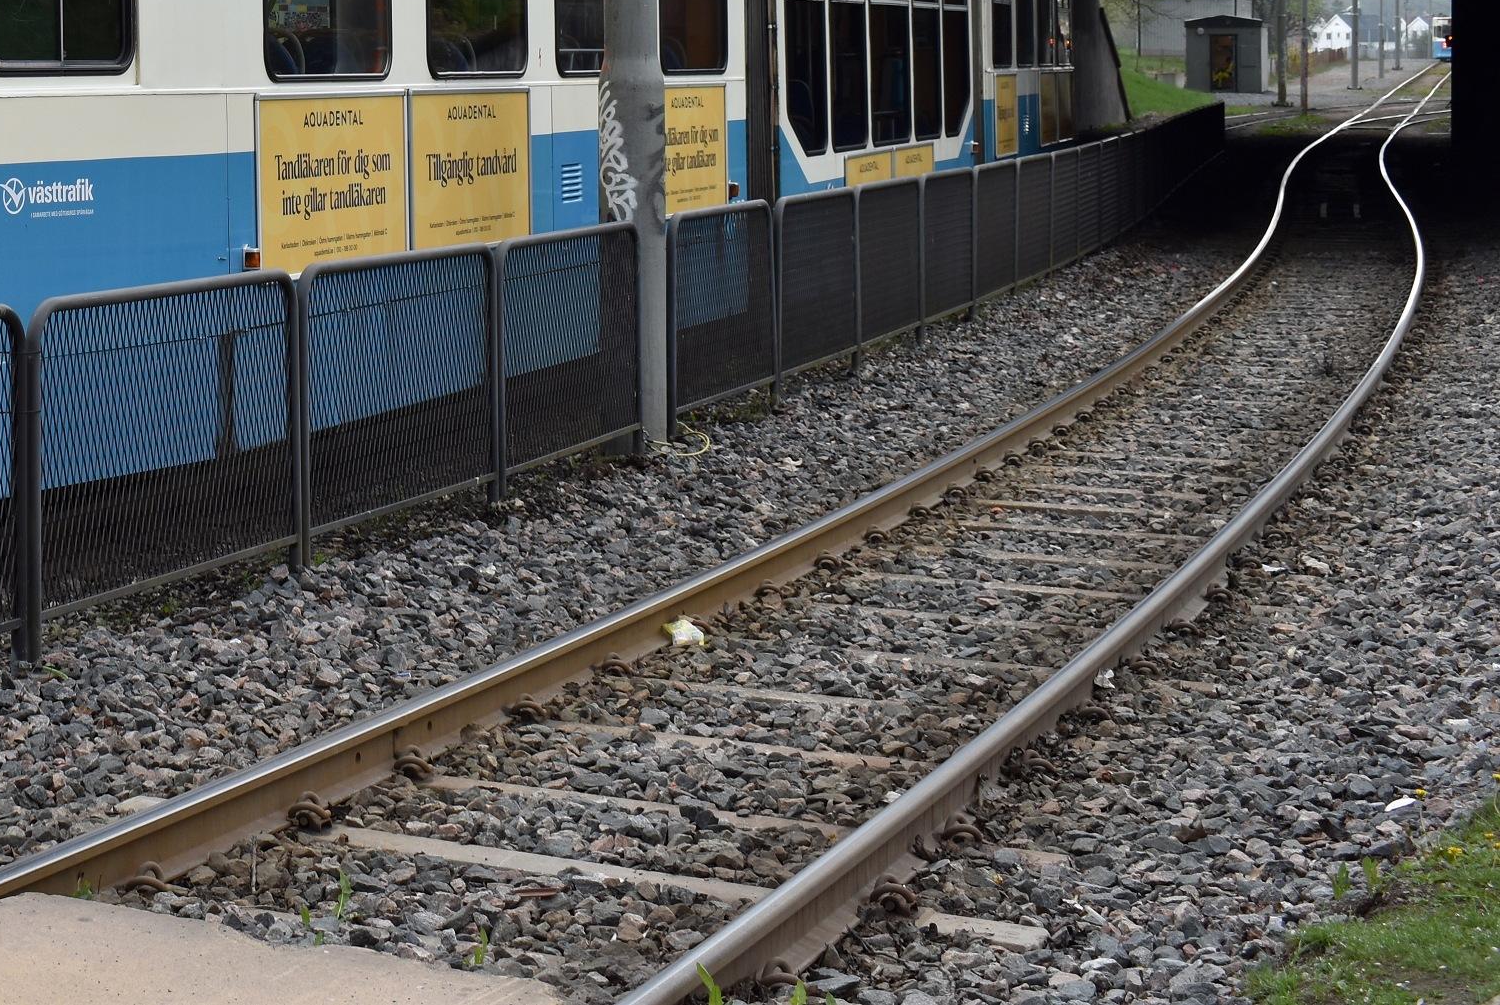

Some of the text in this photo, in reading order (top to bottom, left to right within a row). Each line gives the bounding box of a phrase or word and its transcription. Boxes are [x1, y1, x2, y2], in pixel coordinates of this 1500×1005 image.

[303, 109, 363, 128] AQUADENTAL
[447, 104, 497, 121] AQUADENTAL
[274, 148, 391, 181] Tandläkaren för dig som
[426, 147, 517, 188] Tillgänglig tandvård
[28, 178, 94, 204] västtrafik
[282, 182, 386, 221] inte gillar tandläkaren
